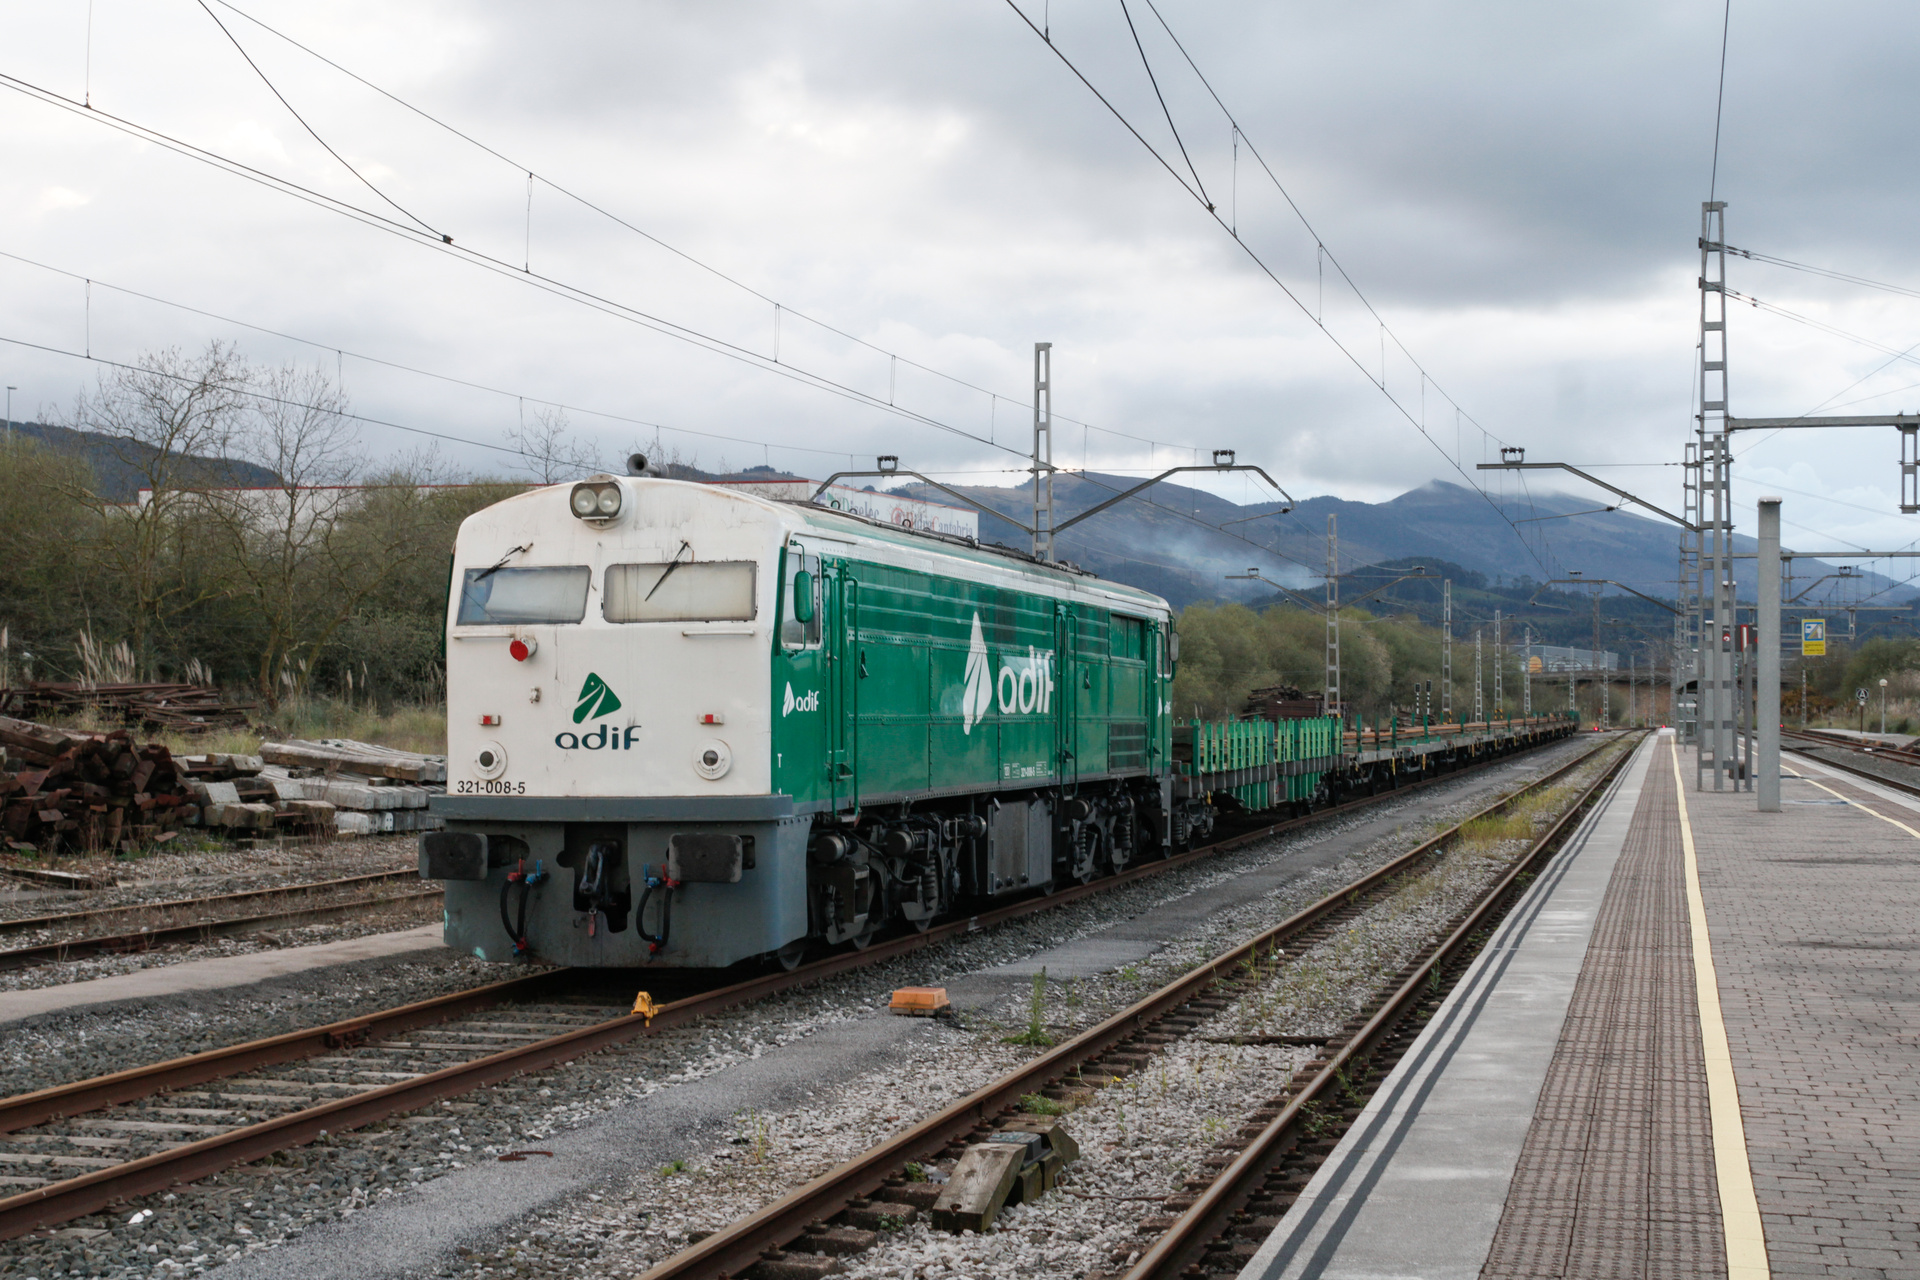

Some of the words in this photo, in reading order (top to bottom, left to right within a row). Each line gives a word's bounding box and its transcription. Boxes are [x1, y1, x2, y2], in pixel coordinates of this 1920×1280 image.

[998, 645, 1055, 715] adif
[795, 689, 820, 712] adif
[554, 723, 642, 750] adif
[456, 780, 526, 795] 321-008-5
